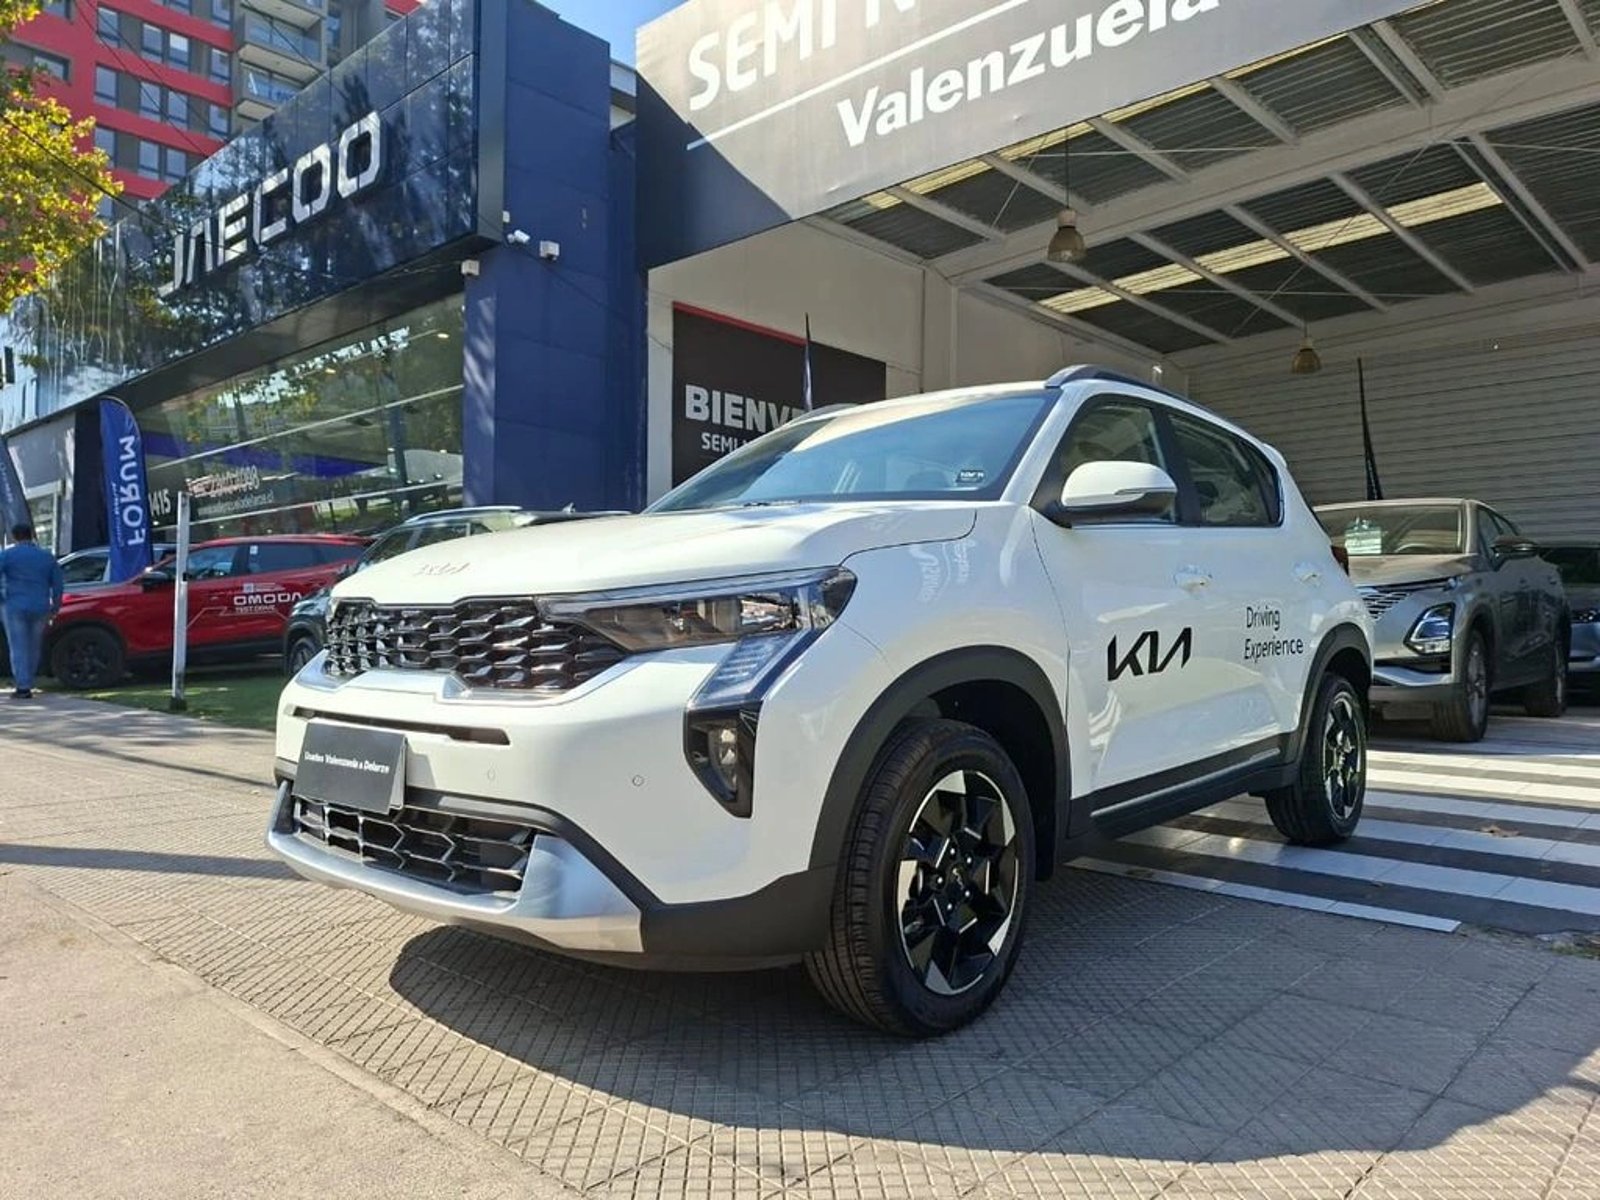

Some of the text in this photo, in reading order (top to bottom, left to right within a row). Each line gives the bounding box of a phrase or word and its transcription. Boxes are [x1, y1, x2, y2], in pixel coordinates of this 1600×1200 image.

[689, 0, 836, 110] SEMI
[157, 111, 381, 298] JAECOO
[701, 432, 738, 453] SEMI
[233, 591, 302, 606] OMODA
[1246, 606, 1280, 631] Driving
[1107, 627, 1192, 682] KIA
[1244, 636, 1304, 663] Experience
